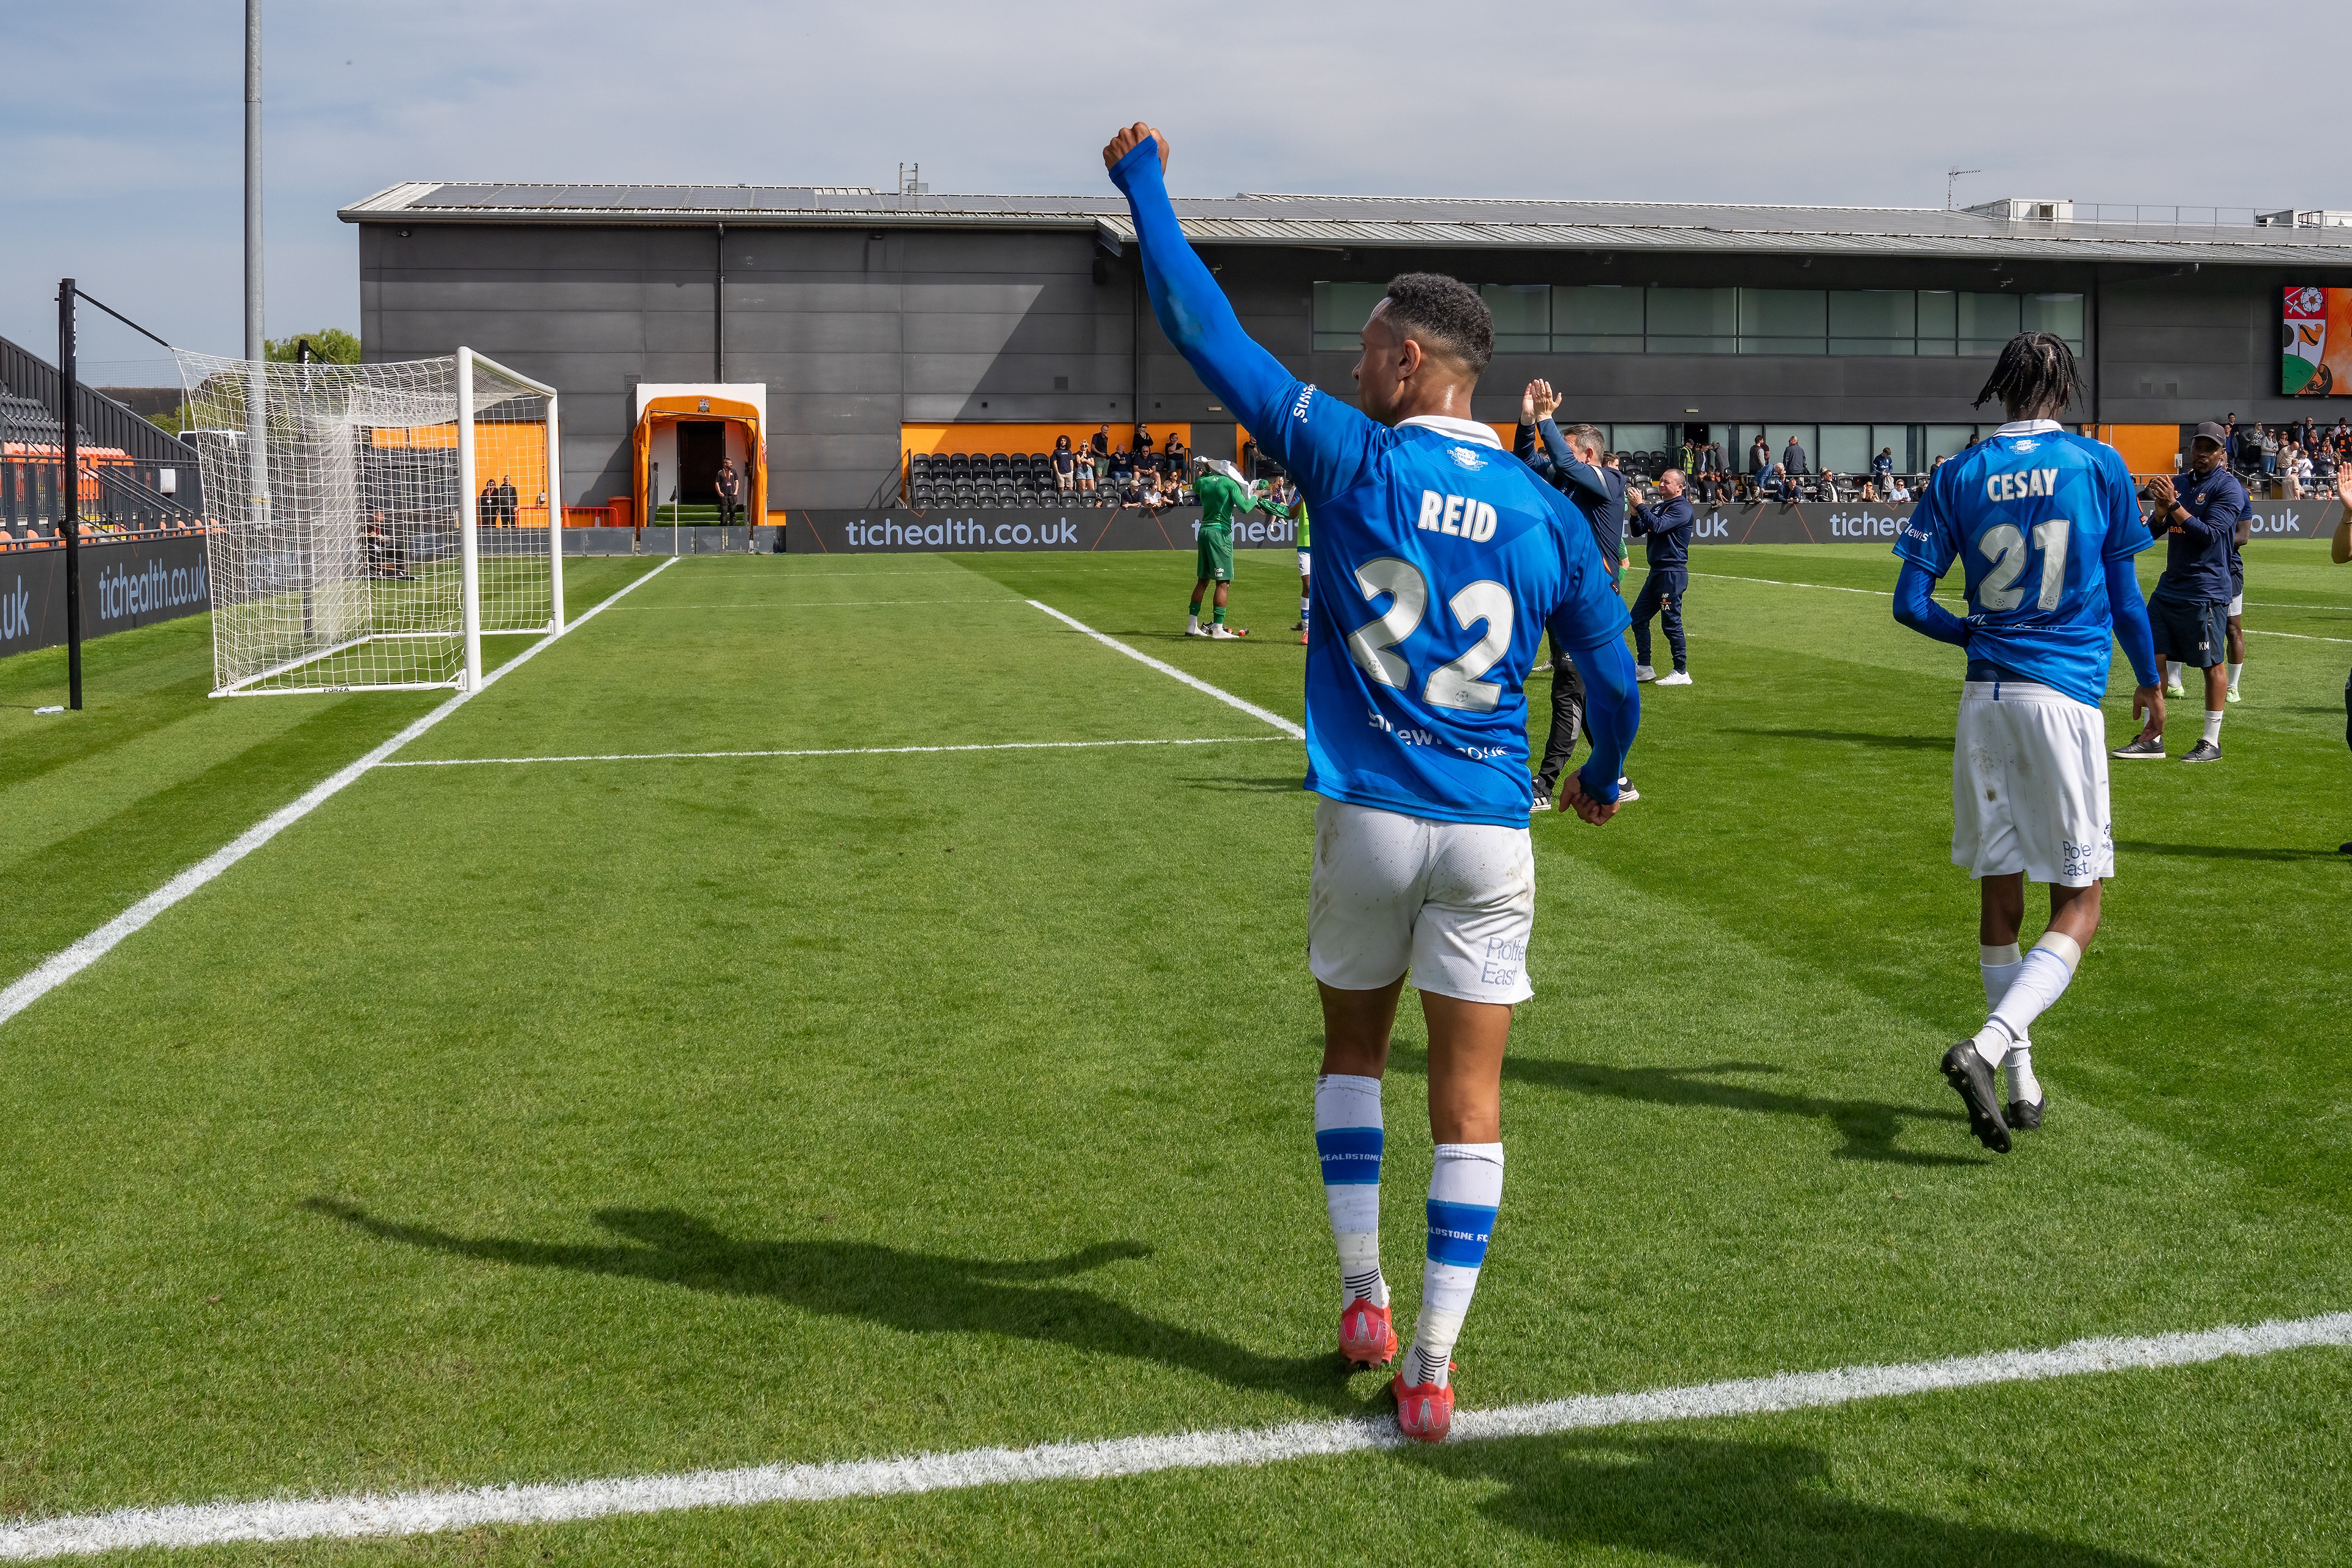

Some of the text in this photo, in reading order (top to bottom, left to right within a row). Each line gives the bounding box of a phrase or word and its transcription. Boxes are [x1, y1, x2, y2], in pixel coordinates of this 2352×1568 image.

[1987, 469, 2059, 502] CESAY
[1418, 489, 1498, 543] REID
[845, 517, 1078, 546] tichealth.co.uk
[1978, 519, 2070, 611] 21
[99, 552, 207, 620] tichealth.co.uk
[1348, 556, 1514, 714] 22
[2199, 641, 2210, 650] KM
[2063, 858, 2089, 876] East
[1486, 937, 1525, 962] Rolfe
[1481, 961, 1518, 986] East
[1477, 1234, 1489, 1242] FC
